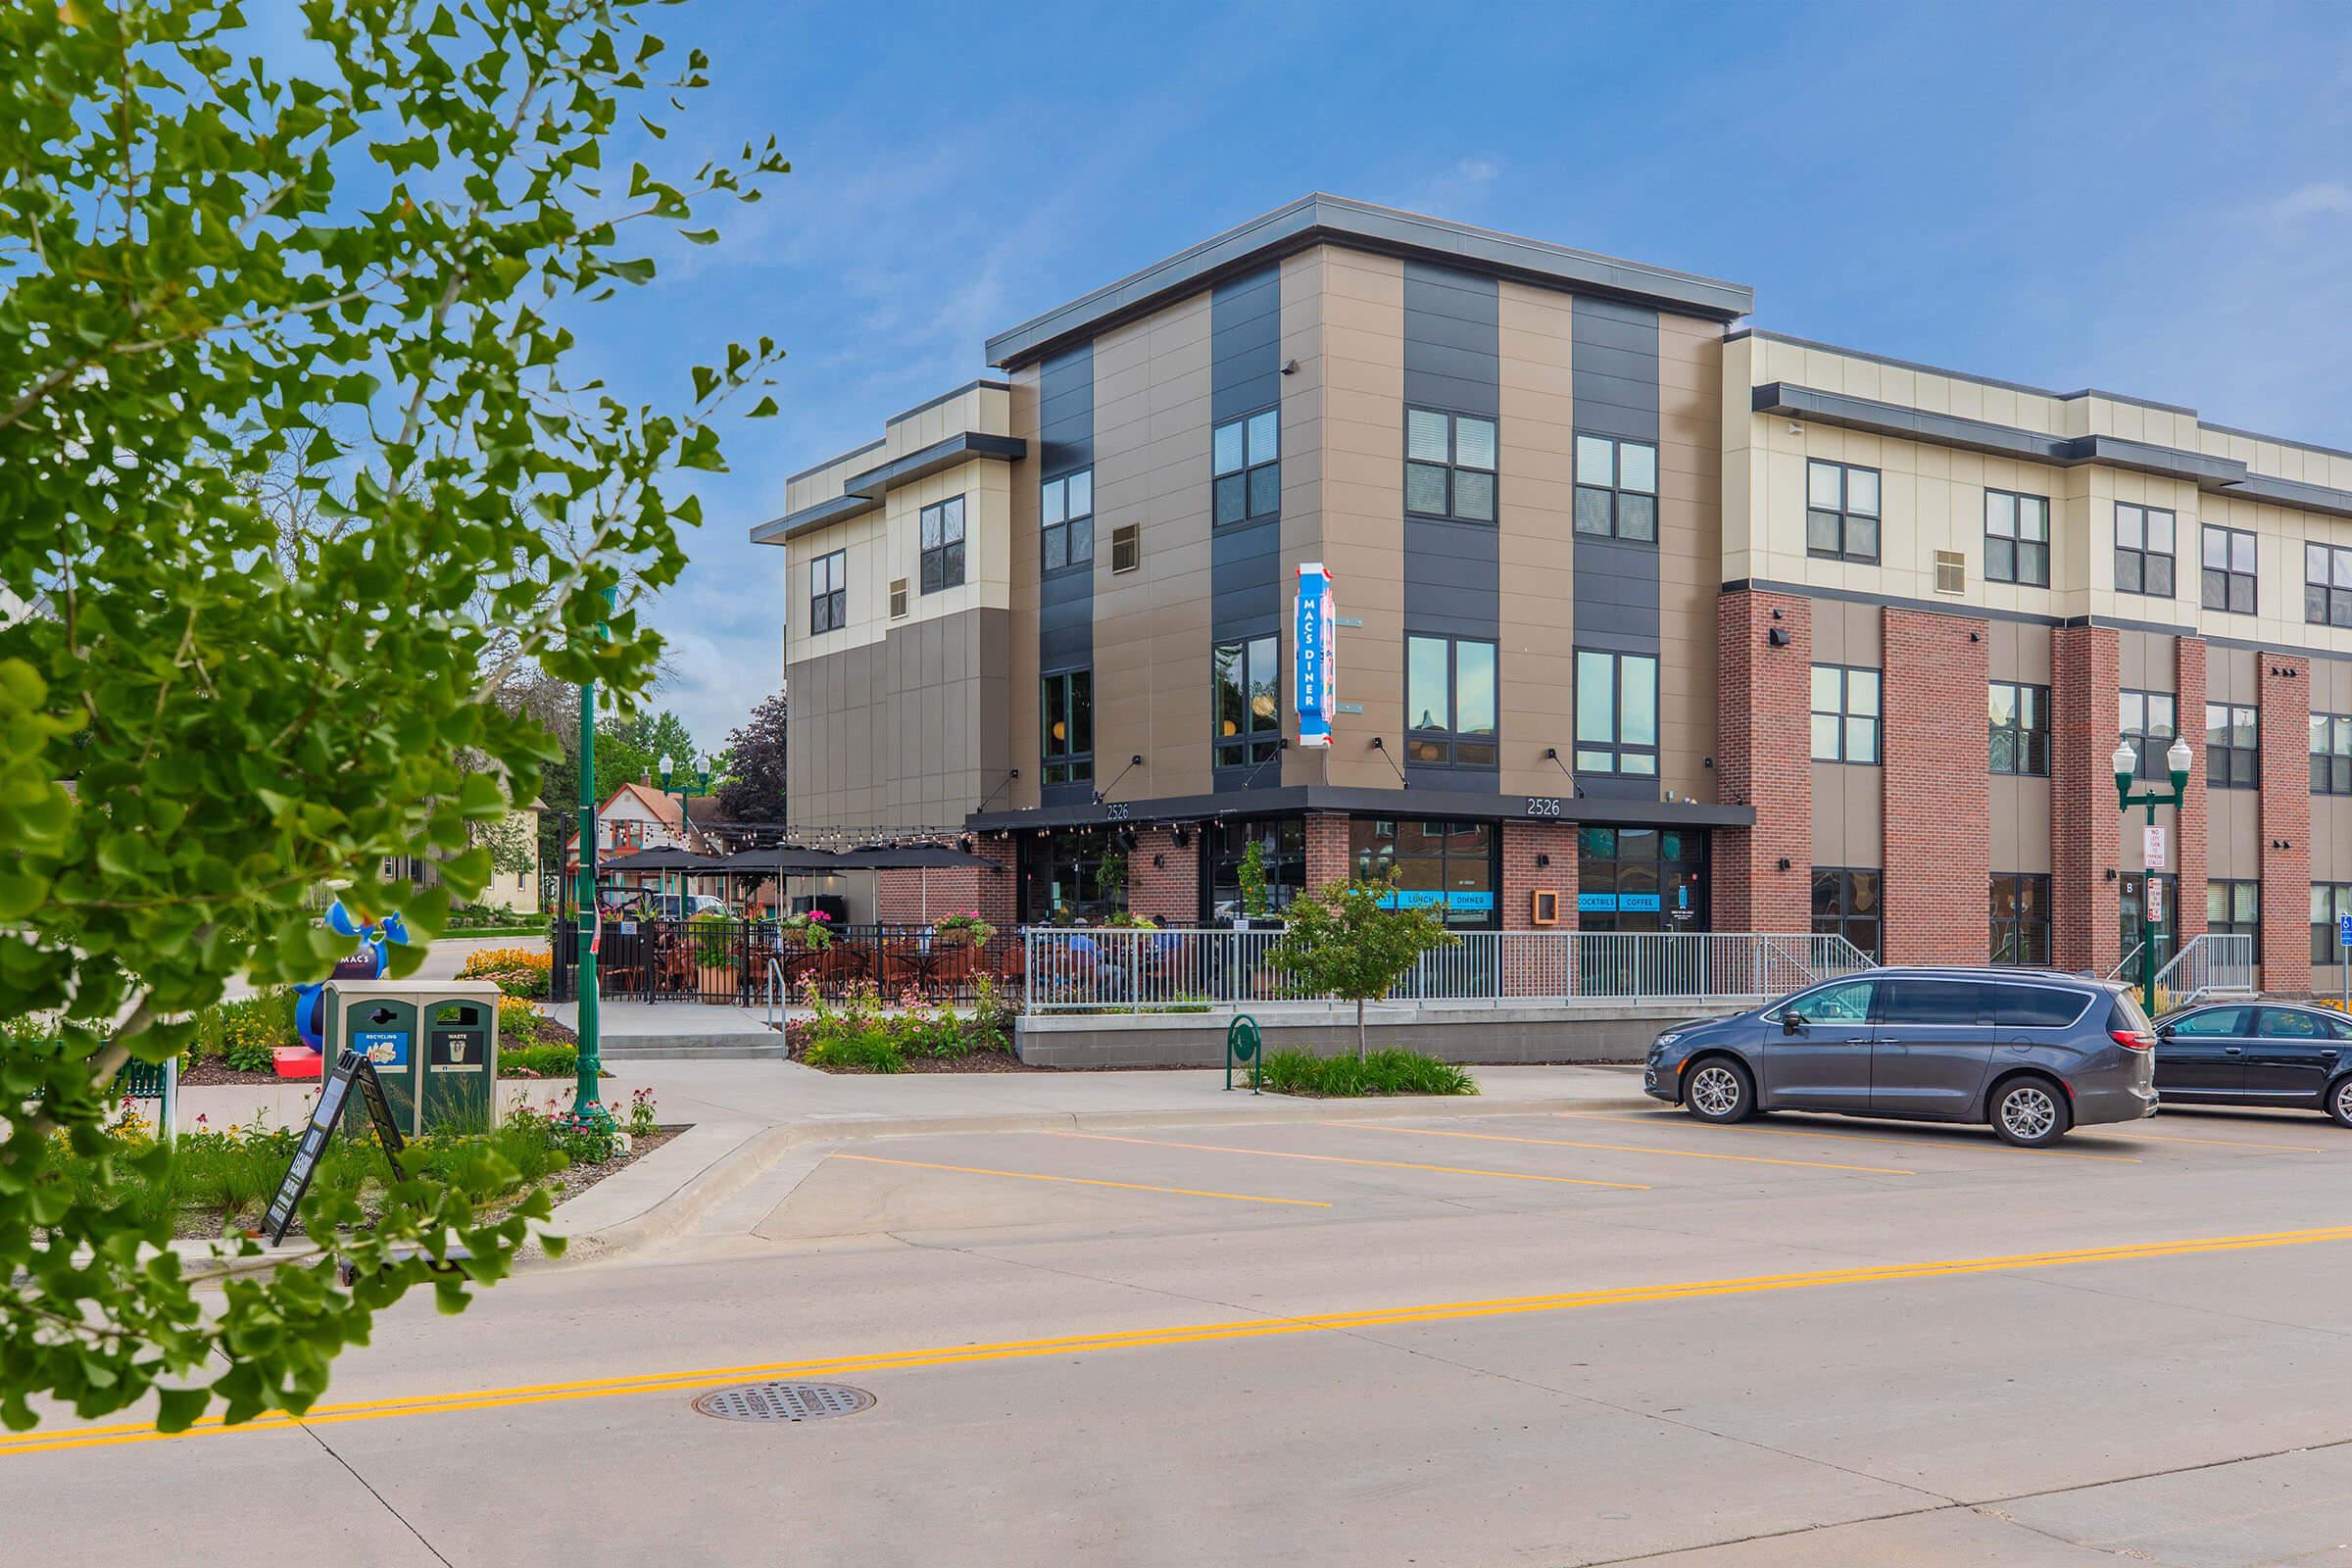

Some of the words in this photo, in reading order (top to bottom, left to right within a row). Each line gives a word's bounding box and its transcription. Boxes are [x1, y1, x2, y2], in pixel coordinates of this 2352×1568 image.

[1304, 599, 1315, 644] MAC'S
[1304, 650, 1314, 706] DINER
[1107, 803, 1129, 819] 2526
[1528, 798, 1560, 815] 2526
[2127, 882, 2133, 893] B
[340, 954, 369, 963] MAC'S
